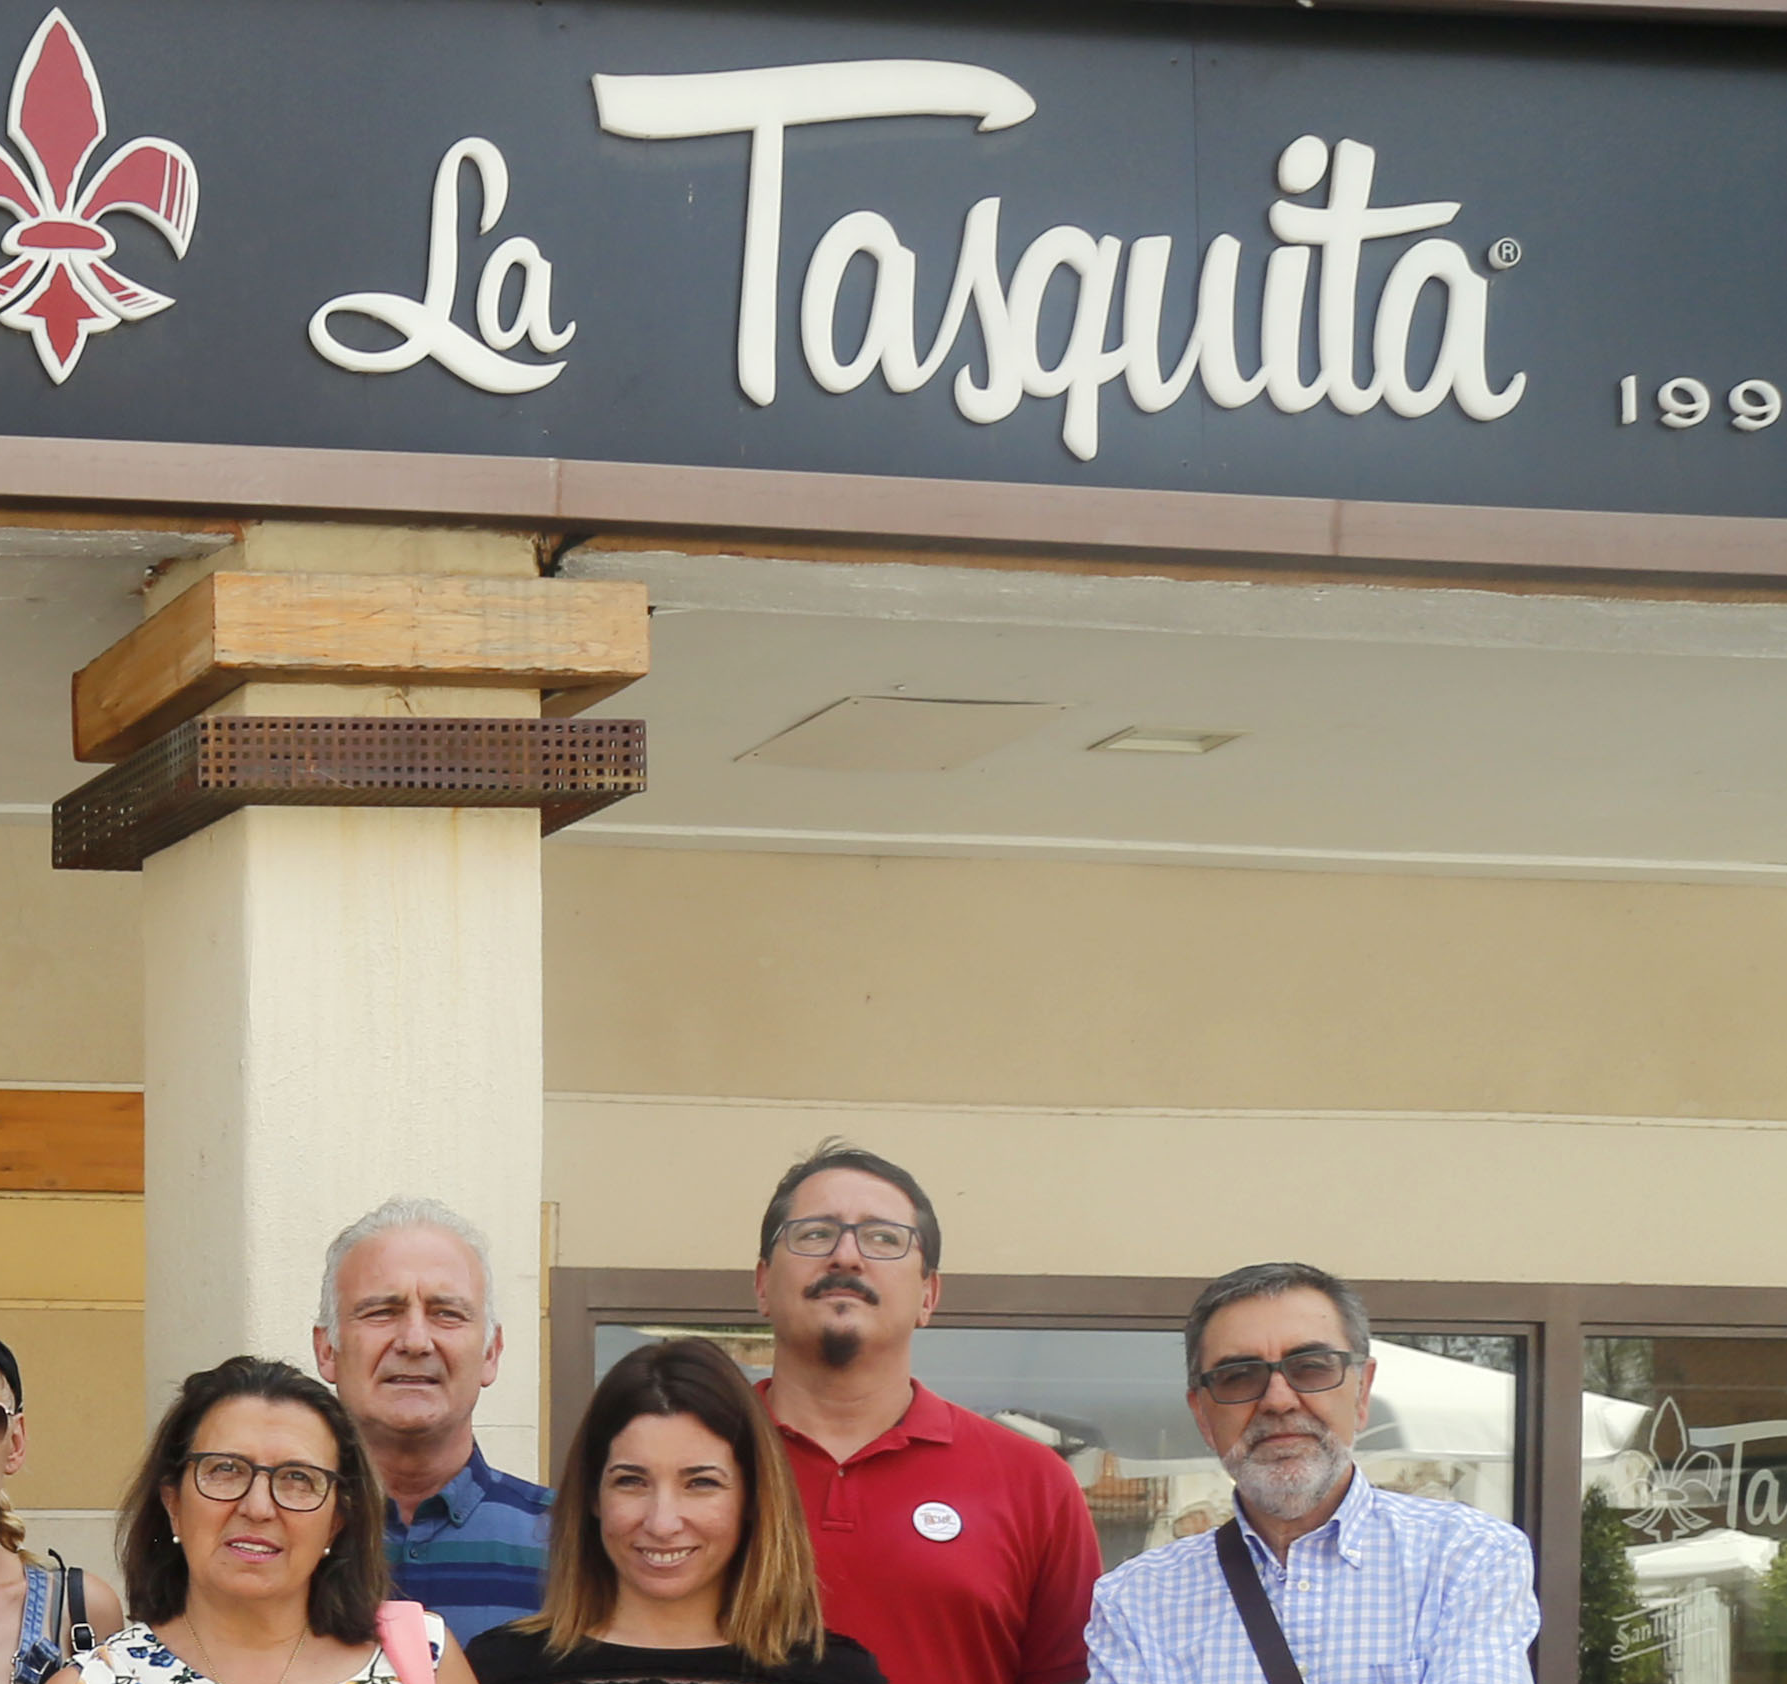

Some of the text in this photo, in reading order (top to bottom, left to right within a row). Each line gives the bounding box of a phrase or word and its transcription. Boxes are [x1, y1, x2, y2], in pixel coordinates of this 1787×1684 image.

[307, 58, 1524, 460] La Tasquita
[1619, 377, 1781, 429] 199
